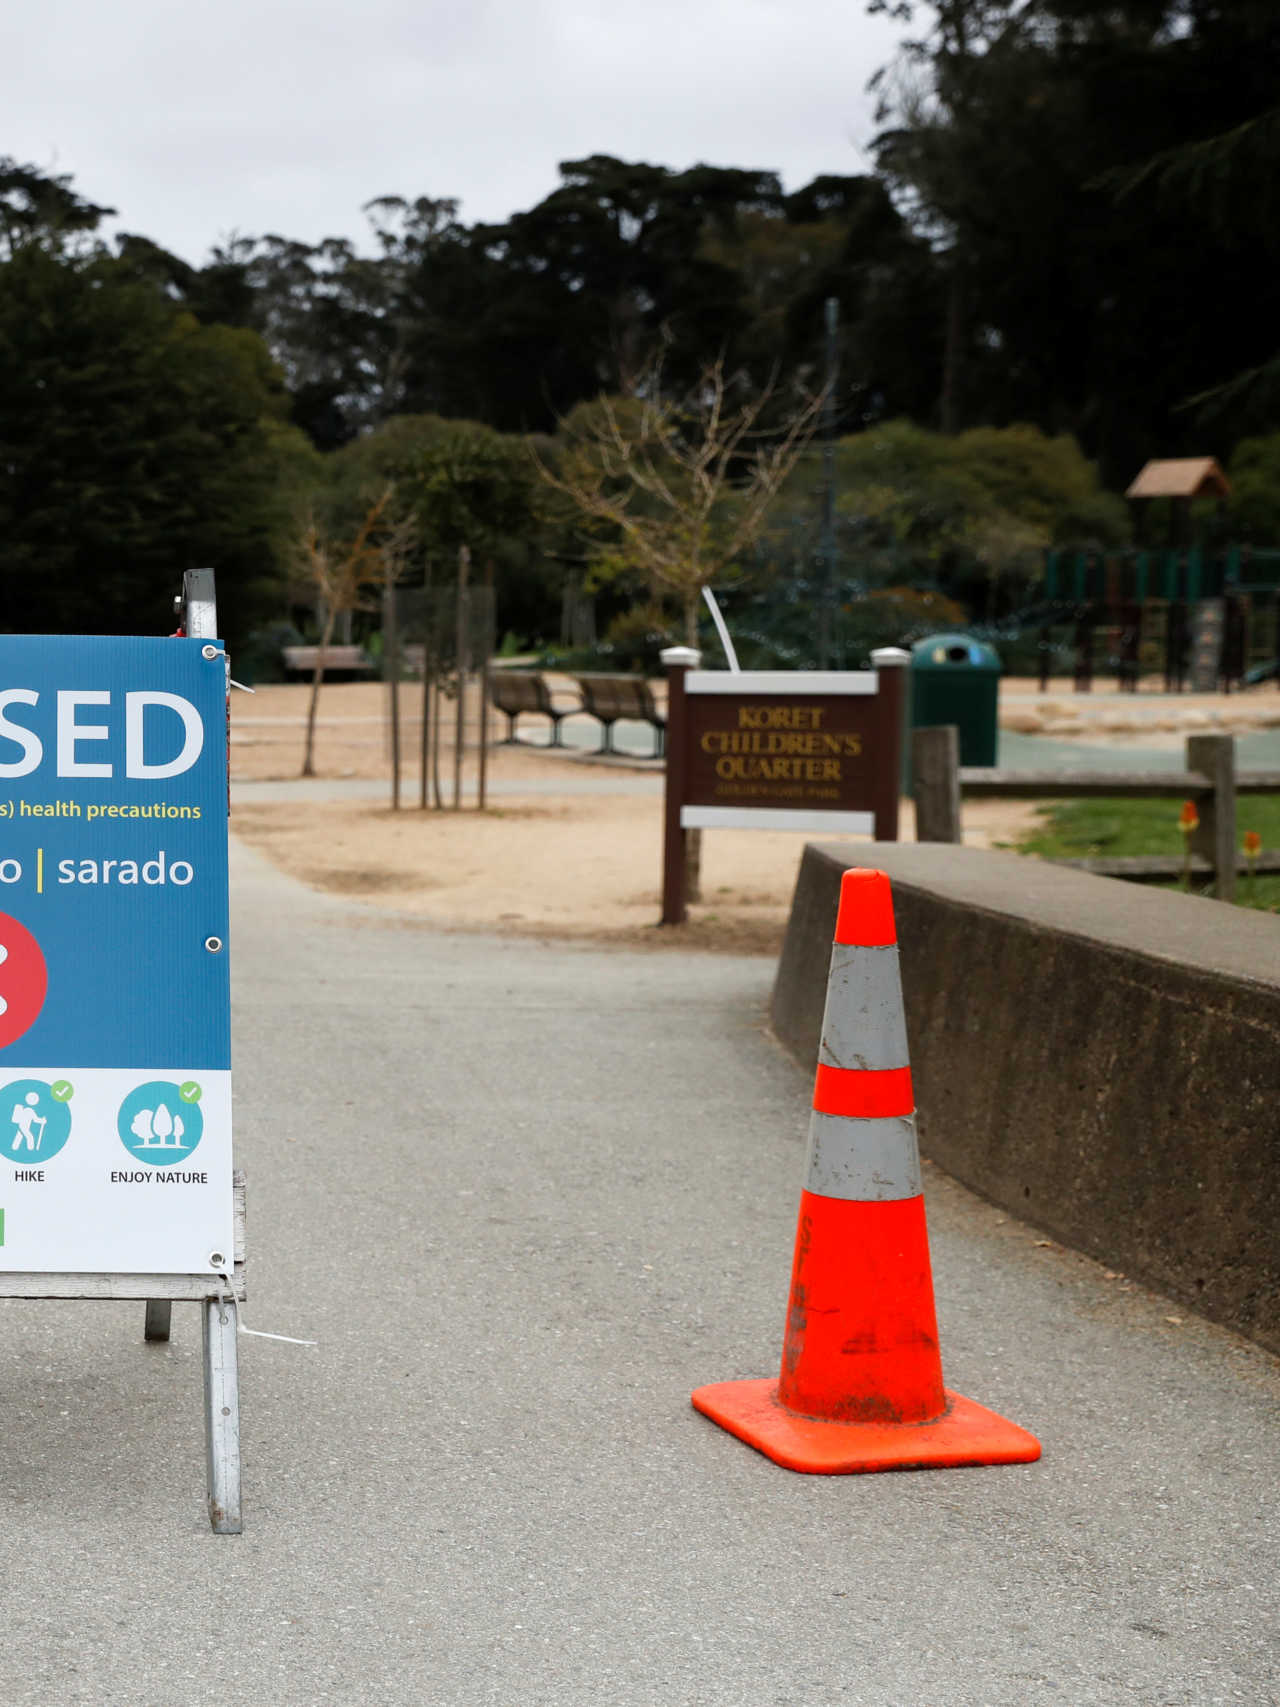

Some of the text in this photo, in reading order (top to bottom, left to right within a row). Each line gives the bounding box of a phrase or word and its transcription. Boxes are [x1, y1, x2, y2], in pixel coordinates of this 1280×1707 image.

[739, 706, 824, 729] KORET
[715, 757, 841, 781] QUARTER
[20, 800, 82, 818] health
[87, 801, 202, 822] precautions
[58, 850, 194, 886] sarado
[15, 1170, 45, 1183] HIKE
[111, 1171, 208, 1184] ENJOY NATURE
